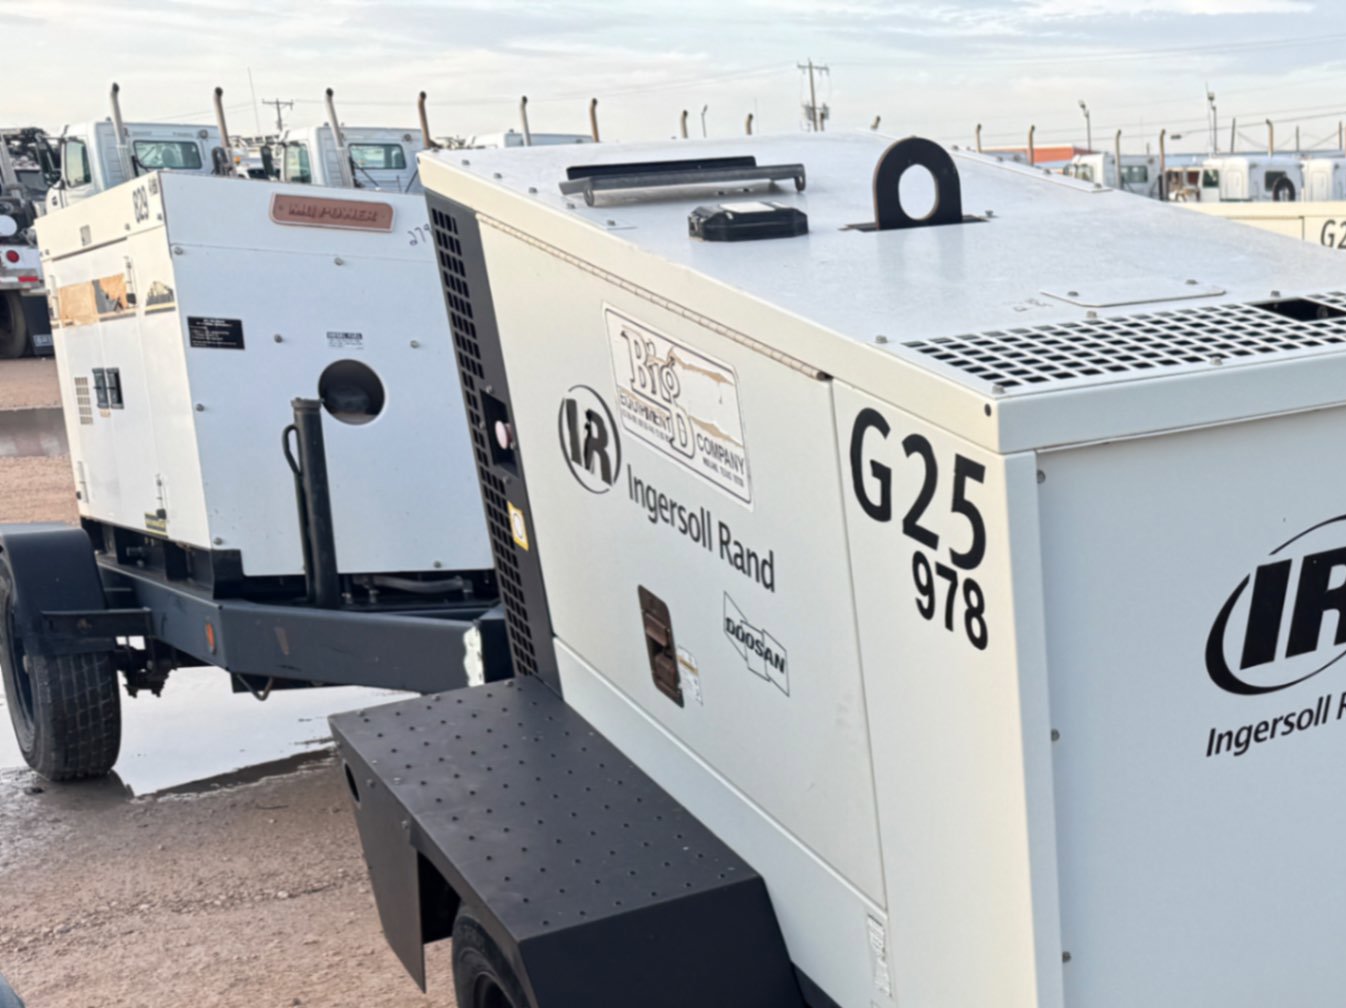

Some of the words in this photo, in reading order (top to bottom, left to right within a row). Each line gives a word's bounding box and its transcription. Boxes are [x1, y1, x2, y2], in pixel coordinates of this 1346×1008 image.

[319, 205, 378, 222] POWER
[696, 432, 746, 476] COMPANY
[849, 407, 986, 571] G25
[627, 463, 712, 552] Ingersoll
[718, 520, 775, 593] Rand
[912, 550, 989, 651] 978
[726, 617, 785, 674] DOOSAN
[1206, 694, 1331, 757] Ingersoll
